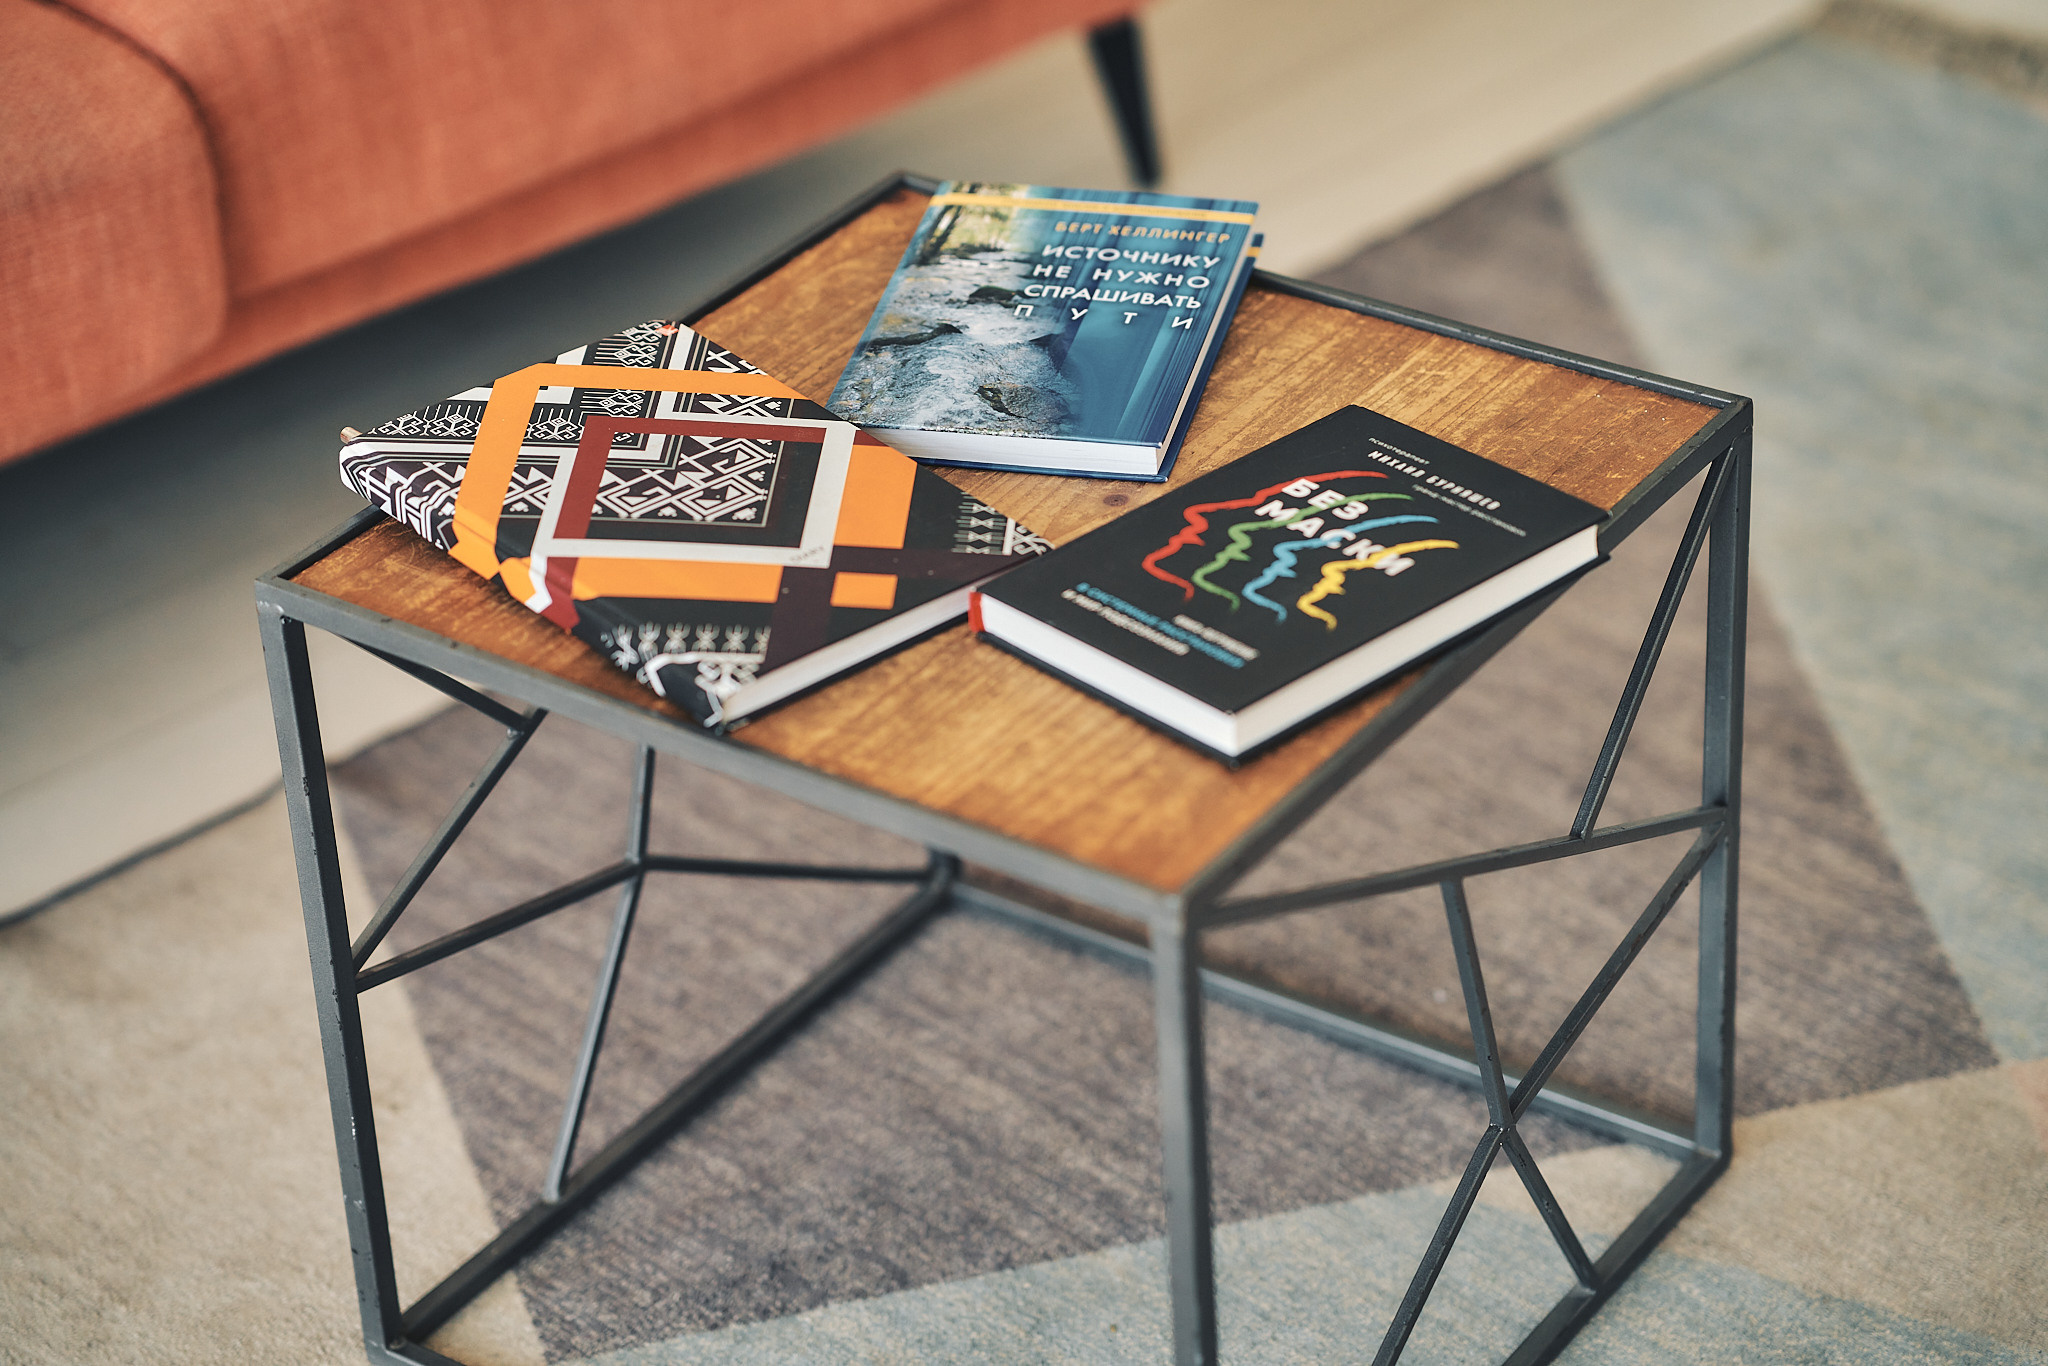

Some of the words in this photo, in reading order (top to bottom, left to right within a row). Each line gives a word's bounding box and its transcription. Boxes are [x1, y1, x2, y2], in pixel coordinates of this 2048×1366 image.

[1055, 221, 1103, 234] БЕРТ
[1108, 224, 1230, 243] ХЕЛЛИНГЕР
[1042, 244, 1220, 269] ИСТОЧНИКУ
[1032, 264, 1072, 279] НЕ
[1093, 268, 1210, 289] НУЖНО
[1023, 284, 1201, 309] СПРАШИВАТЬ
[1368, 450, 1426, 478] МИХАИЛ
[1281, 477, 1369, 520] БЕЗ
[1254, 499, 1415, 576] МАСКИ
